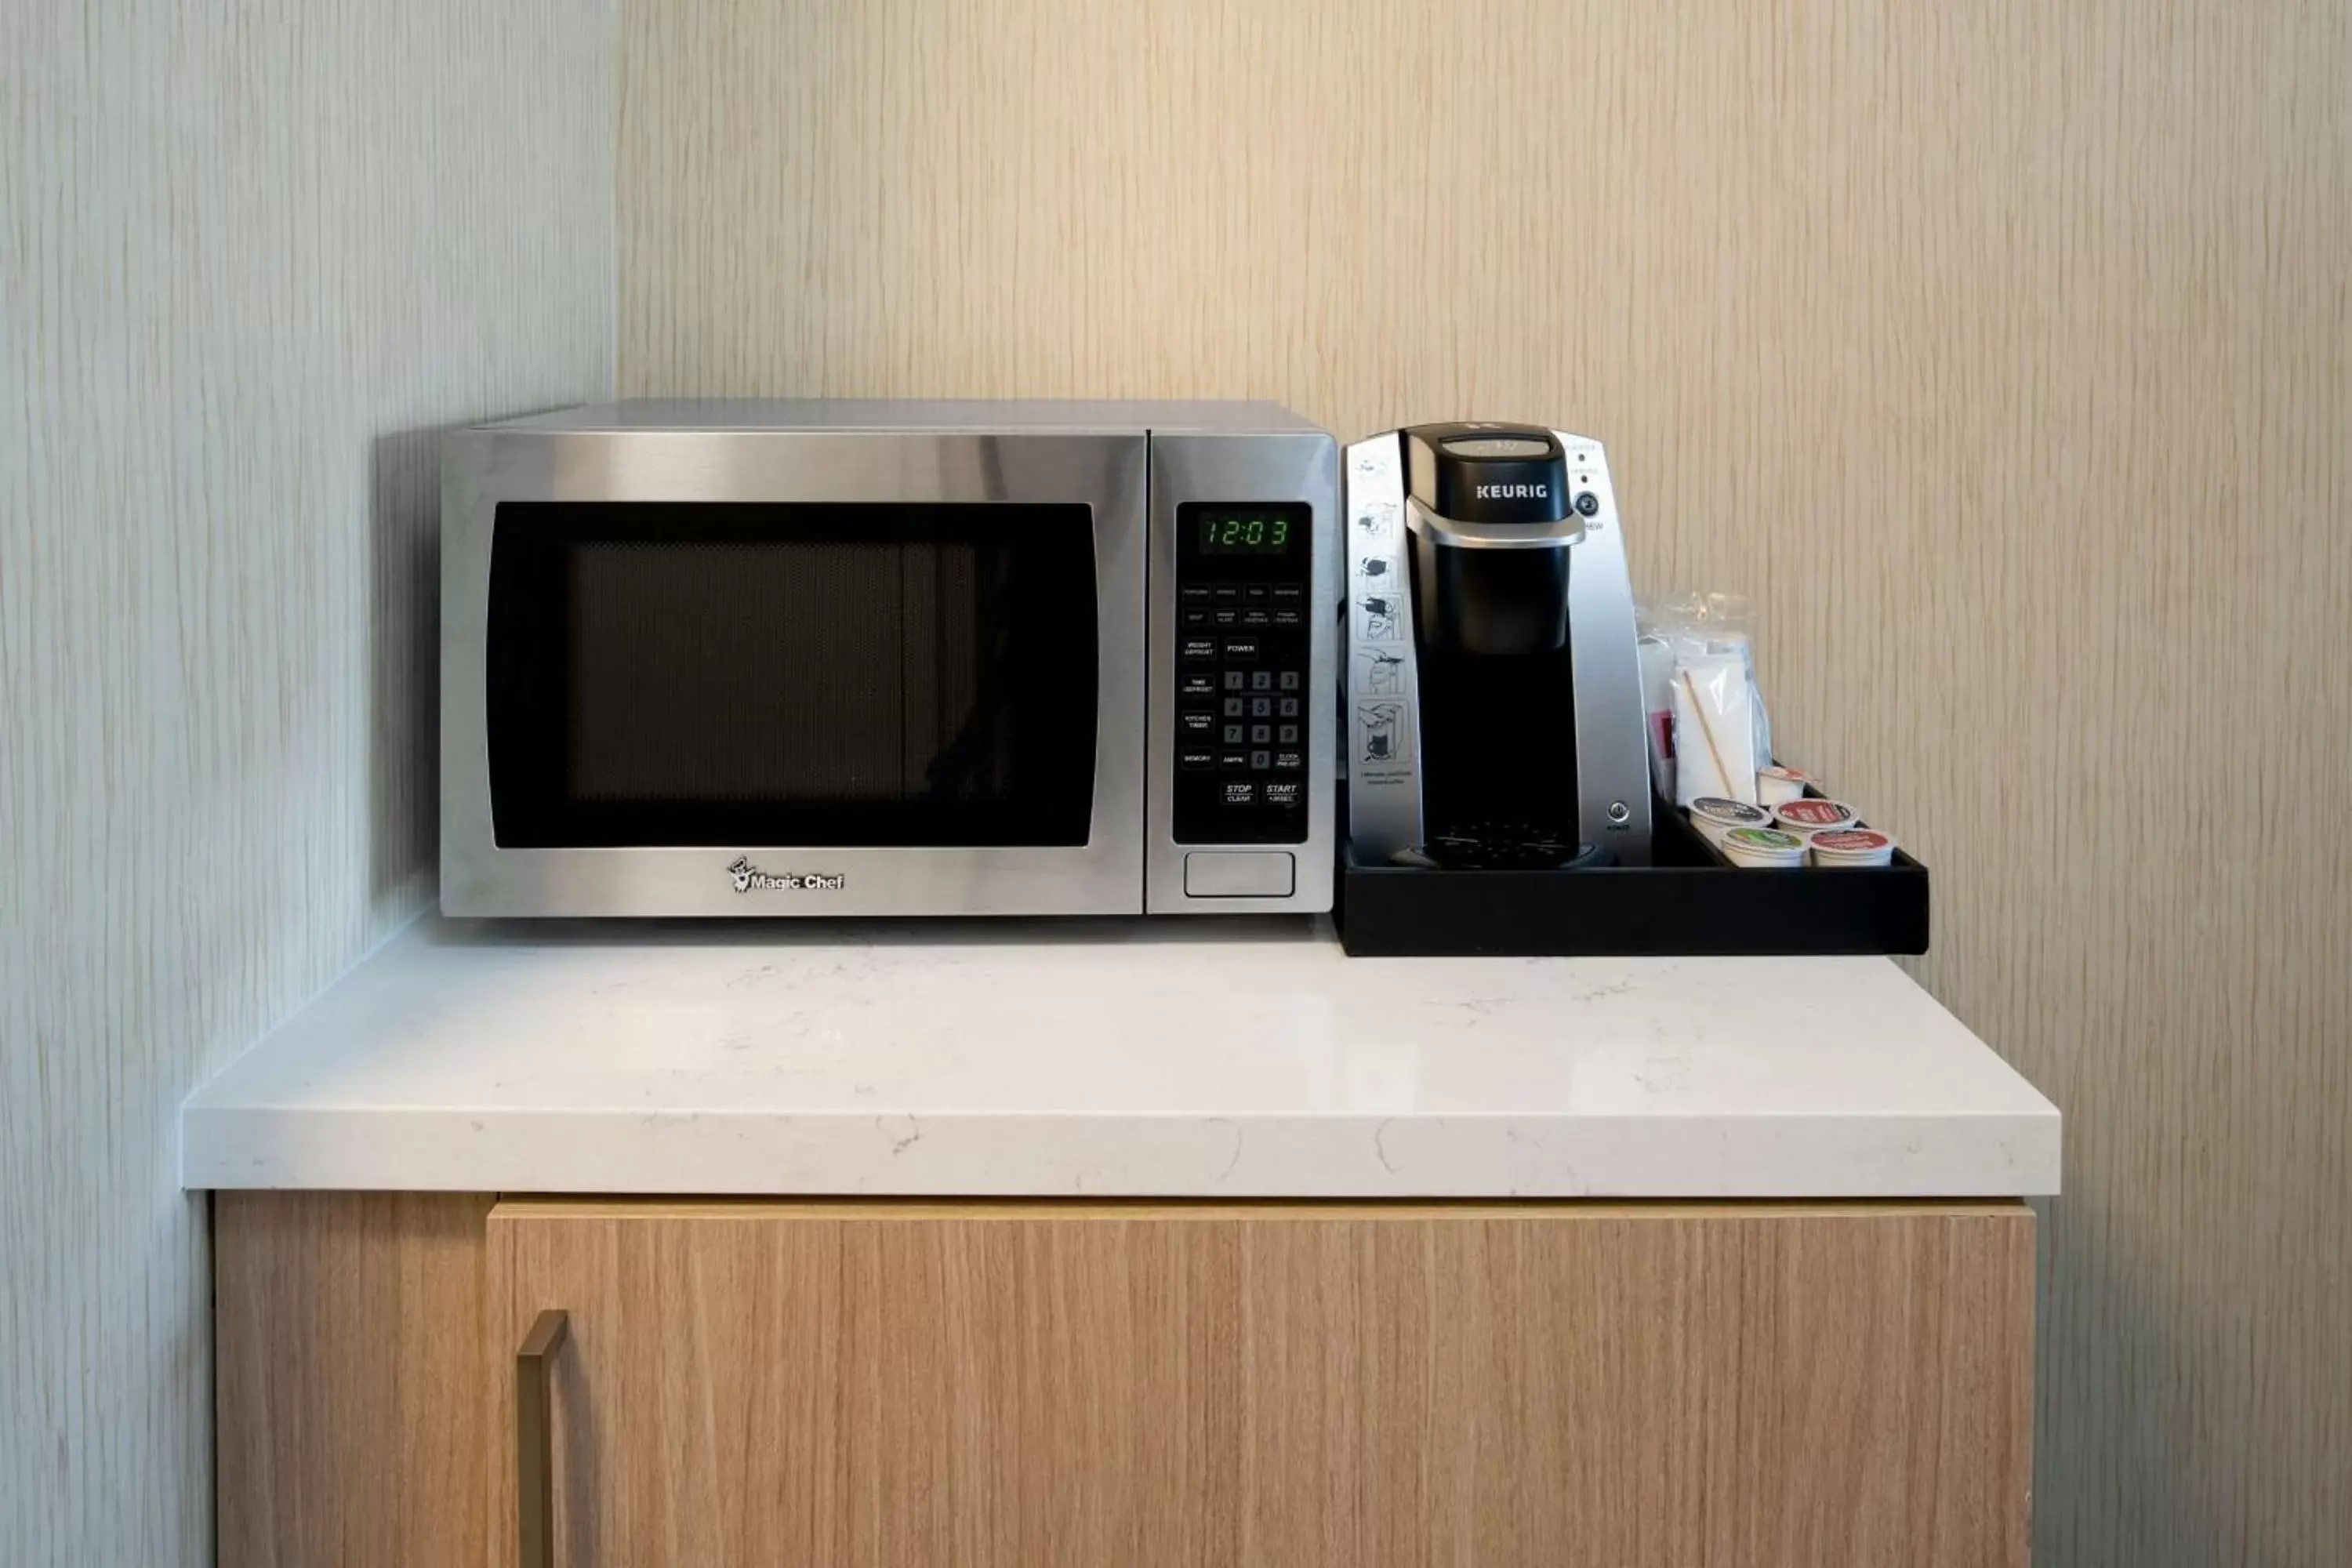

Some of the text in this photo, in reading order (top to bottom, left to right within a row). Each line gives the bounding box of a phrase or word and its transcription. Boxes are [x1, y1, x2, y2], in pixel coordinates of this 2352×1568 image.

[1476, 485, 1548, 499] KEURIG
[1208, 521, 1288, 545] 12:03
[1226, 785, 1252, 793] STOP
[1266, 785, 1298, 793] START
[750, 873, 844, 891] Magic Chef
